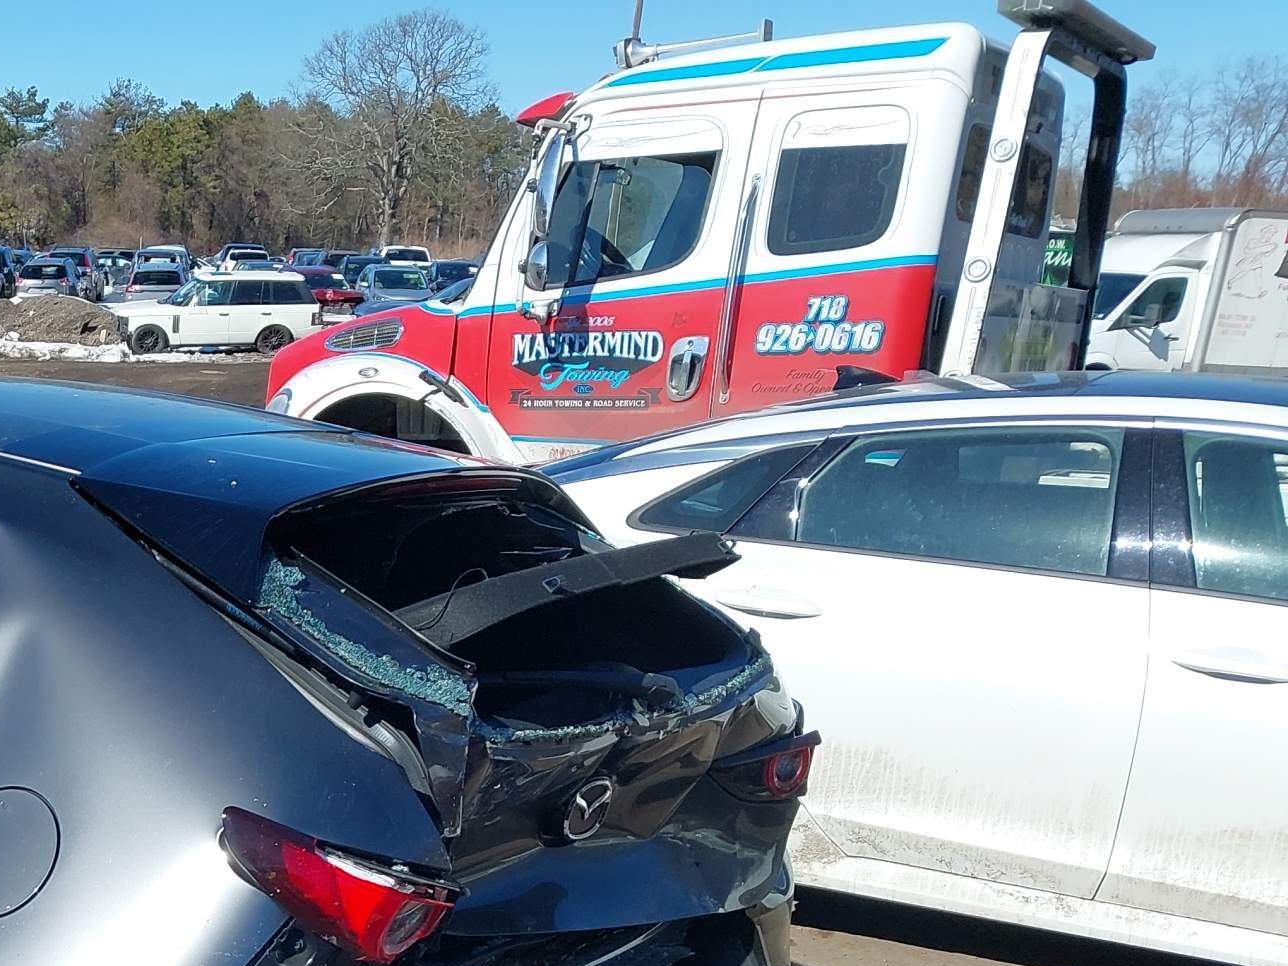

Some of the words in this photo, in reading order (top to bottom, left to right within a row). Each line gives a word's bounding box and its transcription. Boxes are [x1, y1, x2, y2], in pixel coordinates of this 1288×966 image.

[805, 296, 847, 322] 718
[512, 330, 664, 365] MASTERMIND
[538, 361, 631, 391] Towing
[785, 369, 825, 384] Family
[751, 382, 792, 393] Owned
[792, 383, 803, 393] &
[523, 399, 532, 407] 24
[533, 399, 553, 407] HOUR
[555, 399, 583, 407] TOWING
[584, 399, 593, 407] &
[593, 399, 613, 407] ROAD
[615, 399, 646, 407] SERVICE
